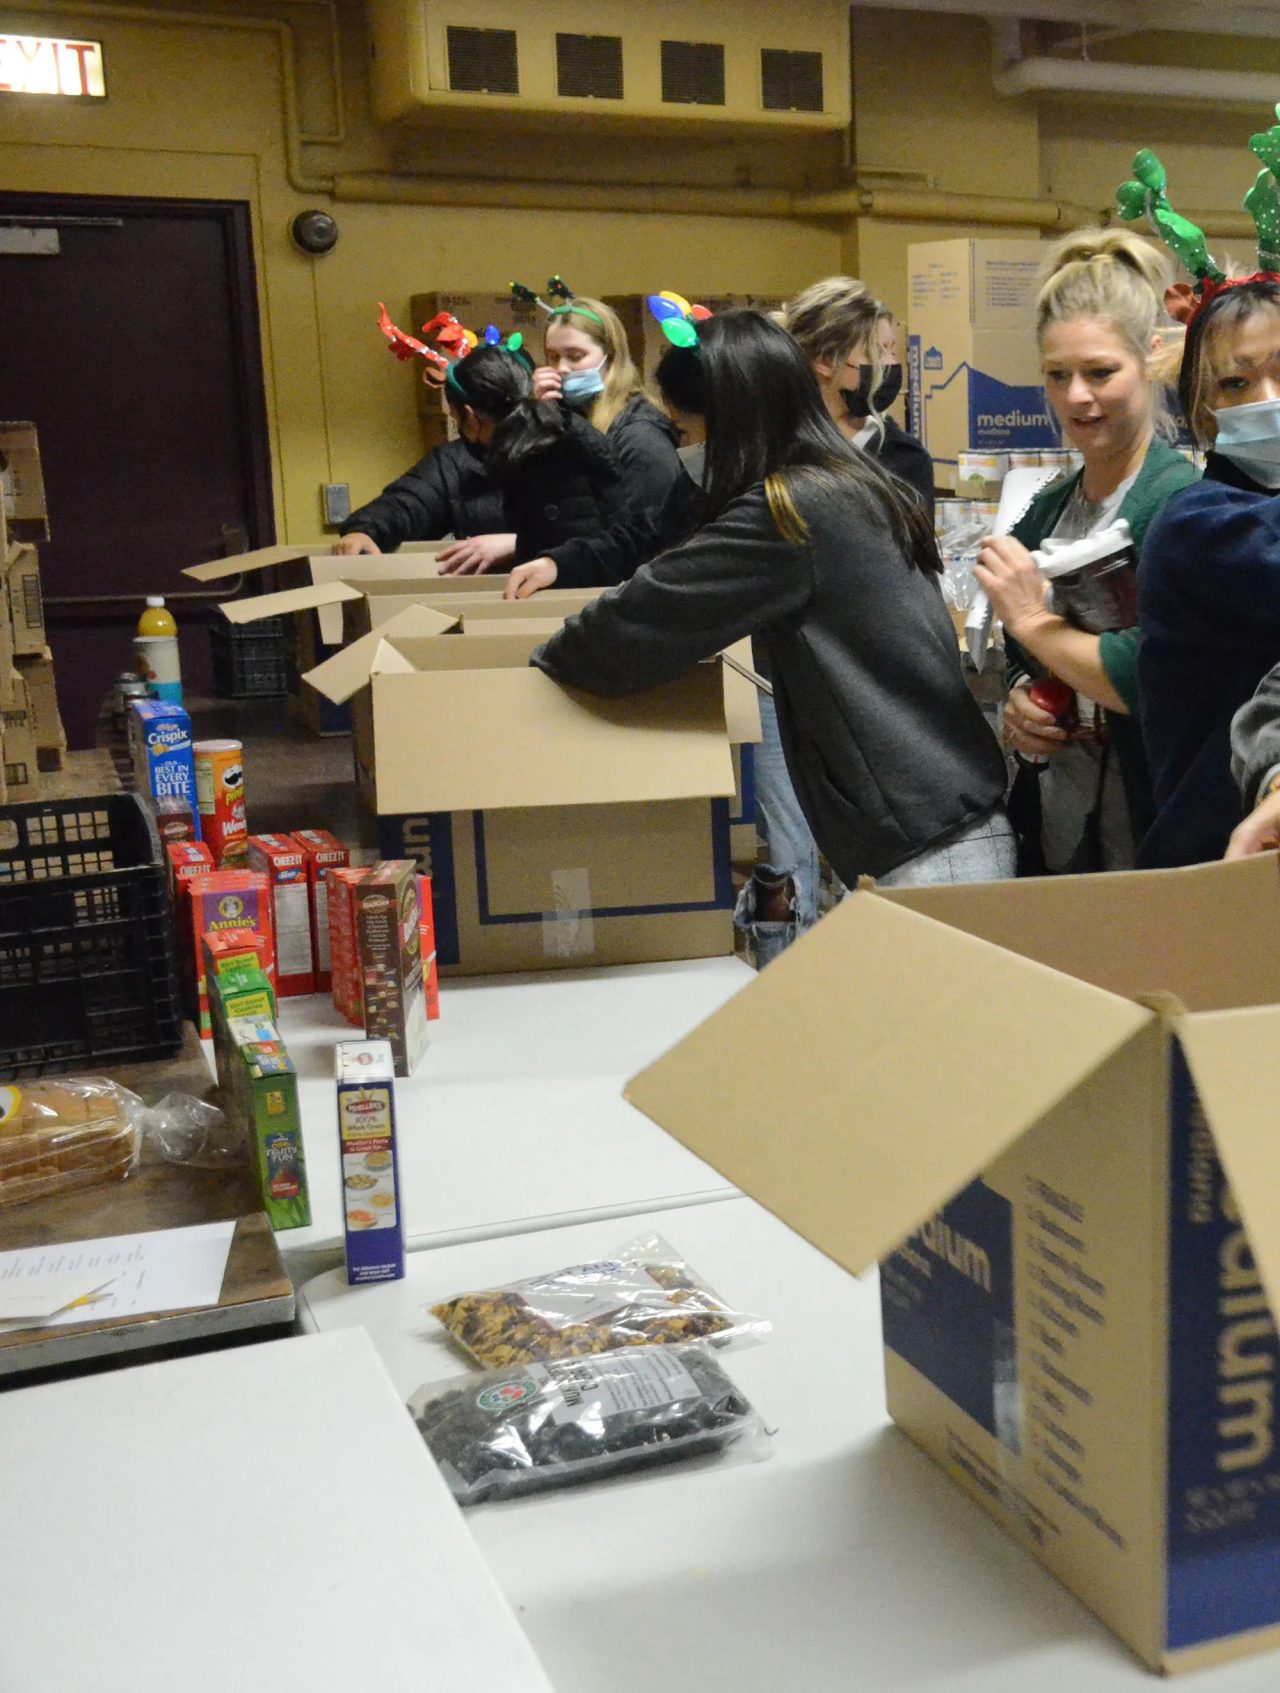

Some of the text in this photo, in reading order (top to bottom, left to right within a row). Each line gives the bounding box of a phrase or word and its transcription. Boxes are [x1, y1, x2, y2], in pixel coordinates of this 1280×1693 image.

[977, 410, 1048, 427] medium
[148, 728, 188, 745] Crispix
[155, 764, 189, 777] BEST IN
[155, 772, 190, 784] EVERY
[156, 782, 192, 796] BITE
[273, 854, 303, 867] CHEEZ-IT
[209, 914, 257, 932] Annie's
[266, 1146, 297, 1156] FRUITY
[272, 1153, 293, 1163] FUN
[1217, 1180, 1277, 1474] dium
